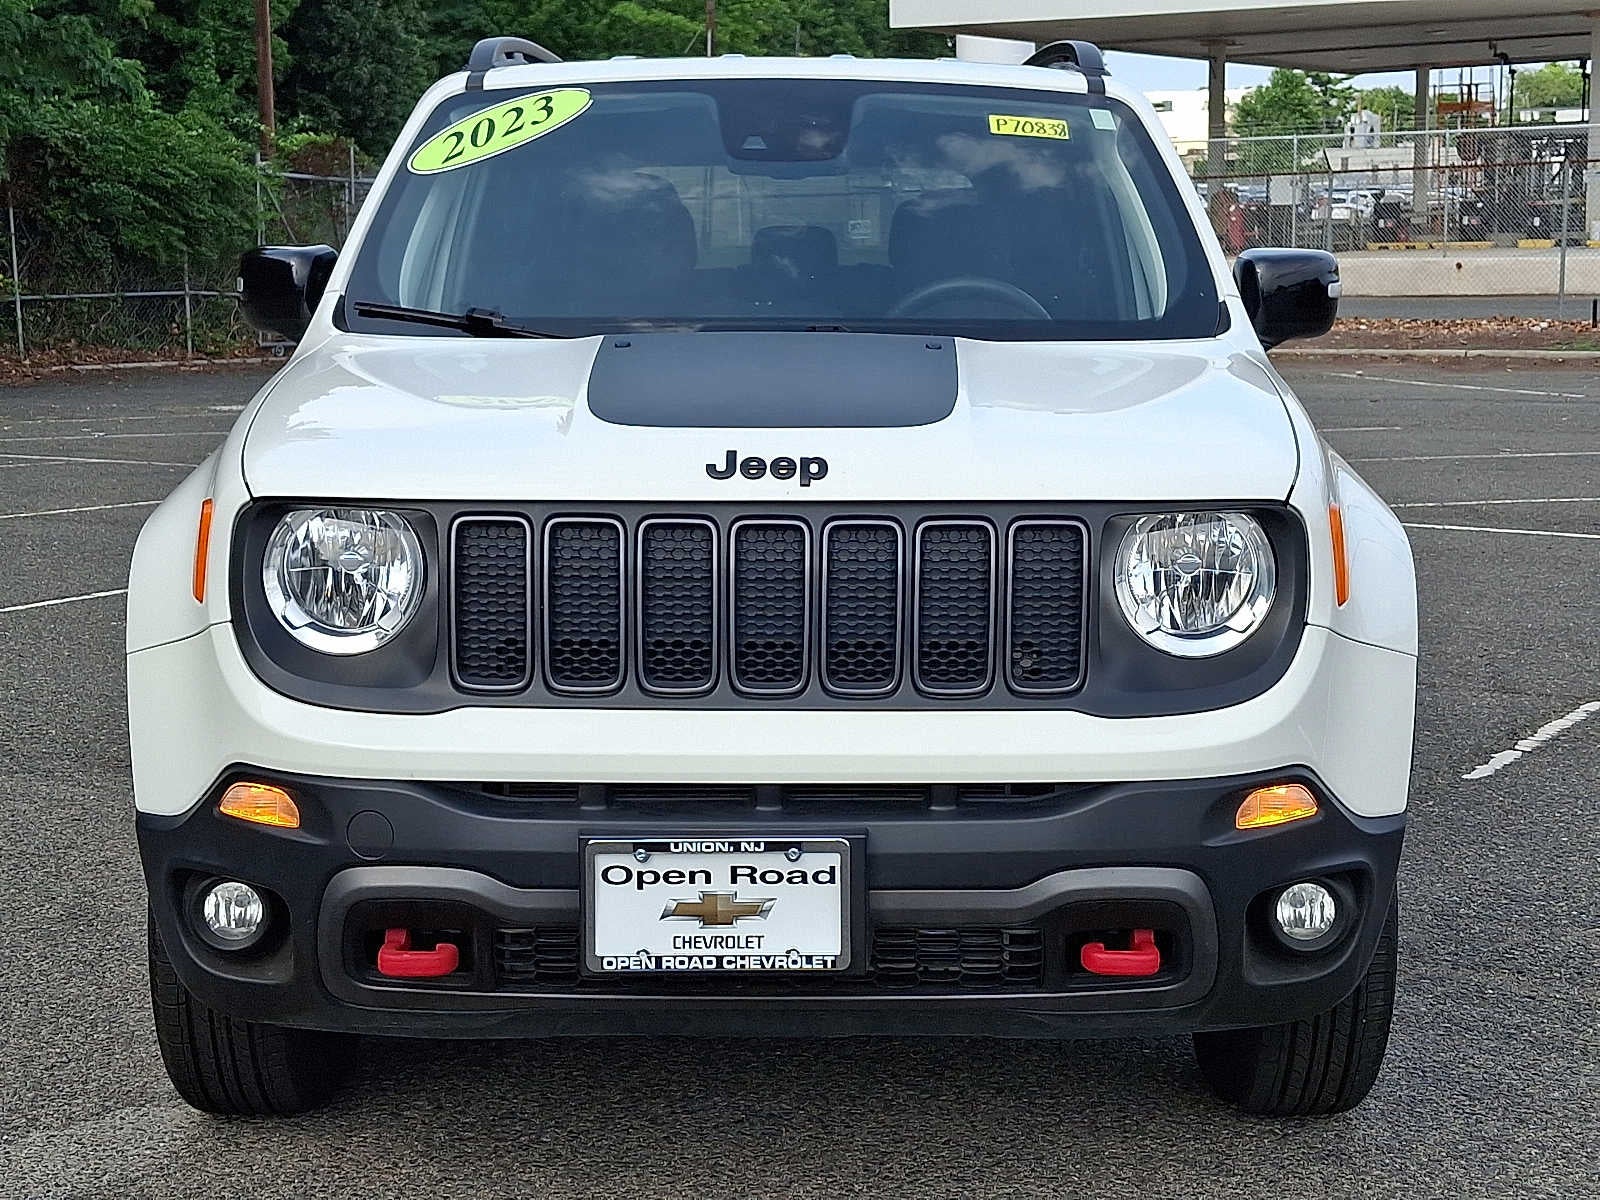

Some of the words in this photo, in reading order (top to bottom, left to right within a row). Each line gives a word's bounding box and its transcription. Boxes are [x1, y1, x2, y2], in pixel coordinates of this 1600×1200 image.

[441, 96, 554, 165] 2023
[705, 450, 829, 487] Jeep
[670, 841, 734, 853] UNION,
[740, 841, 765, 852] NJ
[601, 865, 712, 890] Open
[730, 865, 837, 886] Road
[673, 935, 765, 949] CHEVROLET
[602, 956, 656, 970] OPEN
[662, 955, 717, 969] ROAD
[722, 955, 836, 969] CHEVROLET
